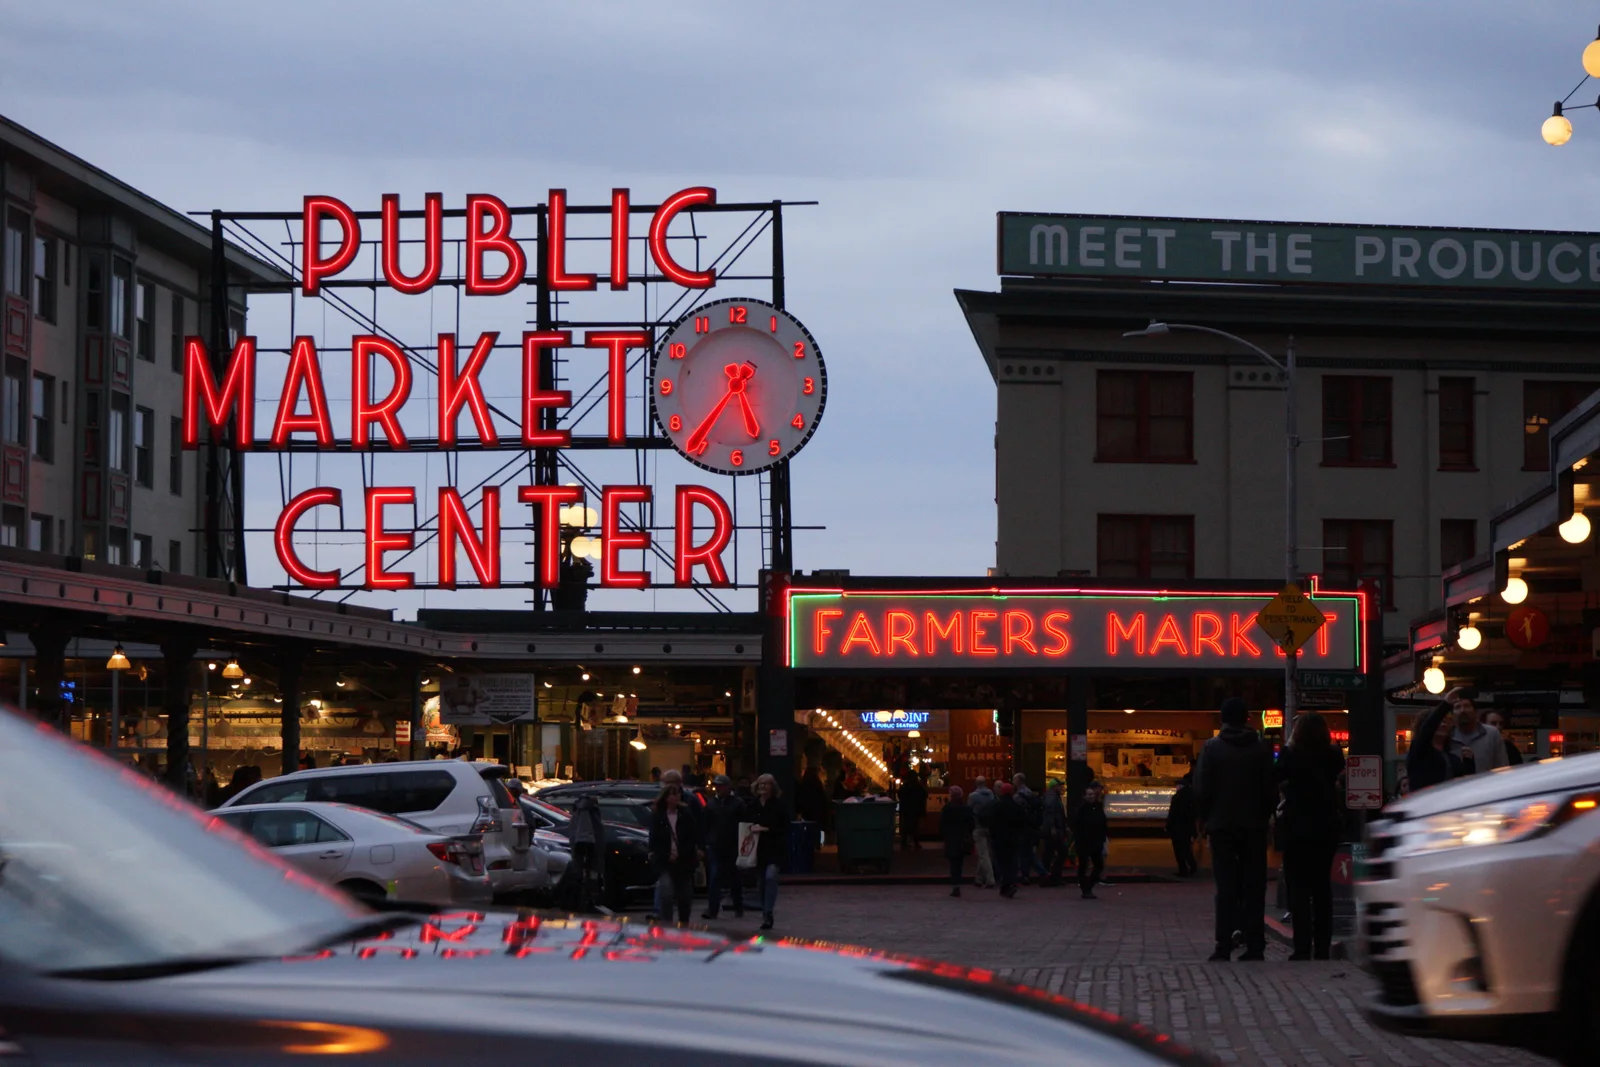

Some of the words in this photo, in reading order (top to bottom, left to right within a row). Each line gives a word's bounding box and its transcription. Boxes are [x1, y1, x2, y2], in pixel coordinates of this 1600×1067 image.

[302, 186, 717, 297] PUBLIC
[1028, 223, 1176, 269] MEET
[1211, 230, 1313, 274] THE
[729, 305, 747, 323] 12
[695, 316, 709, 333] 11
[770, 316, 777, 333] 1
[669, 343, 686, 359] 10
[794, 341, 805, 359] 2
[181, 330, 652, 451] MARKET
[660, 379, 673, 396] 9
[803, 377, 814, 395] 3
[669, 414, 682, 432] 8
[791, 413, 805, 430] 4
[768, 439, 780, 456] 5
[730, 449, 743, 466] 6
[274, 484, 736, 590] CENTER
[1280, 595, 1303, 605] YIELD
[1286, 604, 1296, 613] TO
[1264, 614, 1317, 624] PEDESTRIANS
[817, 611, 1070, 655] FARMERS
[1108, 612, 1337, 657] MARKT
[1303, 673, 1330, 687] Pike
[861, 711, 929, 722] VIOINT
[966, 734, 1001, 747] LOWER
[956, 752, 1011, 761] MARKET
[1351, 768, 1377, 778] STOPS
